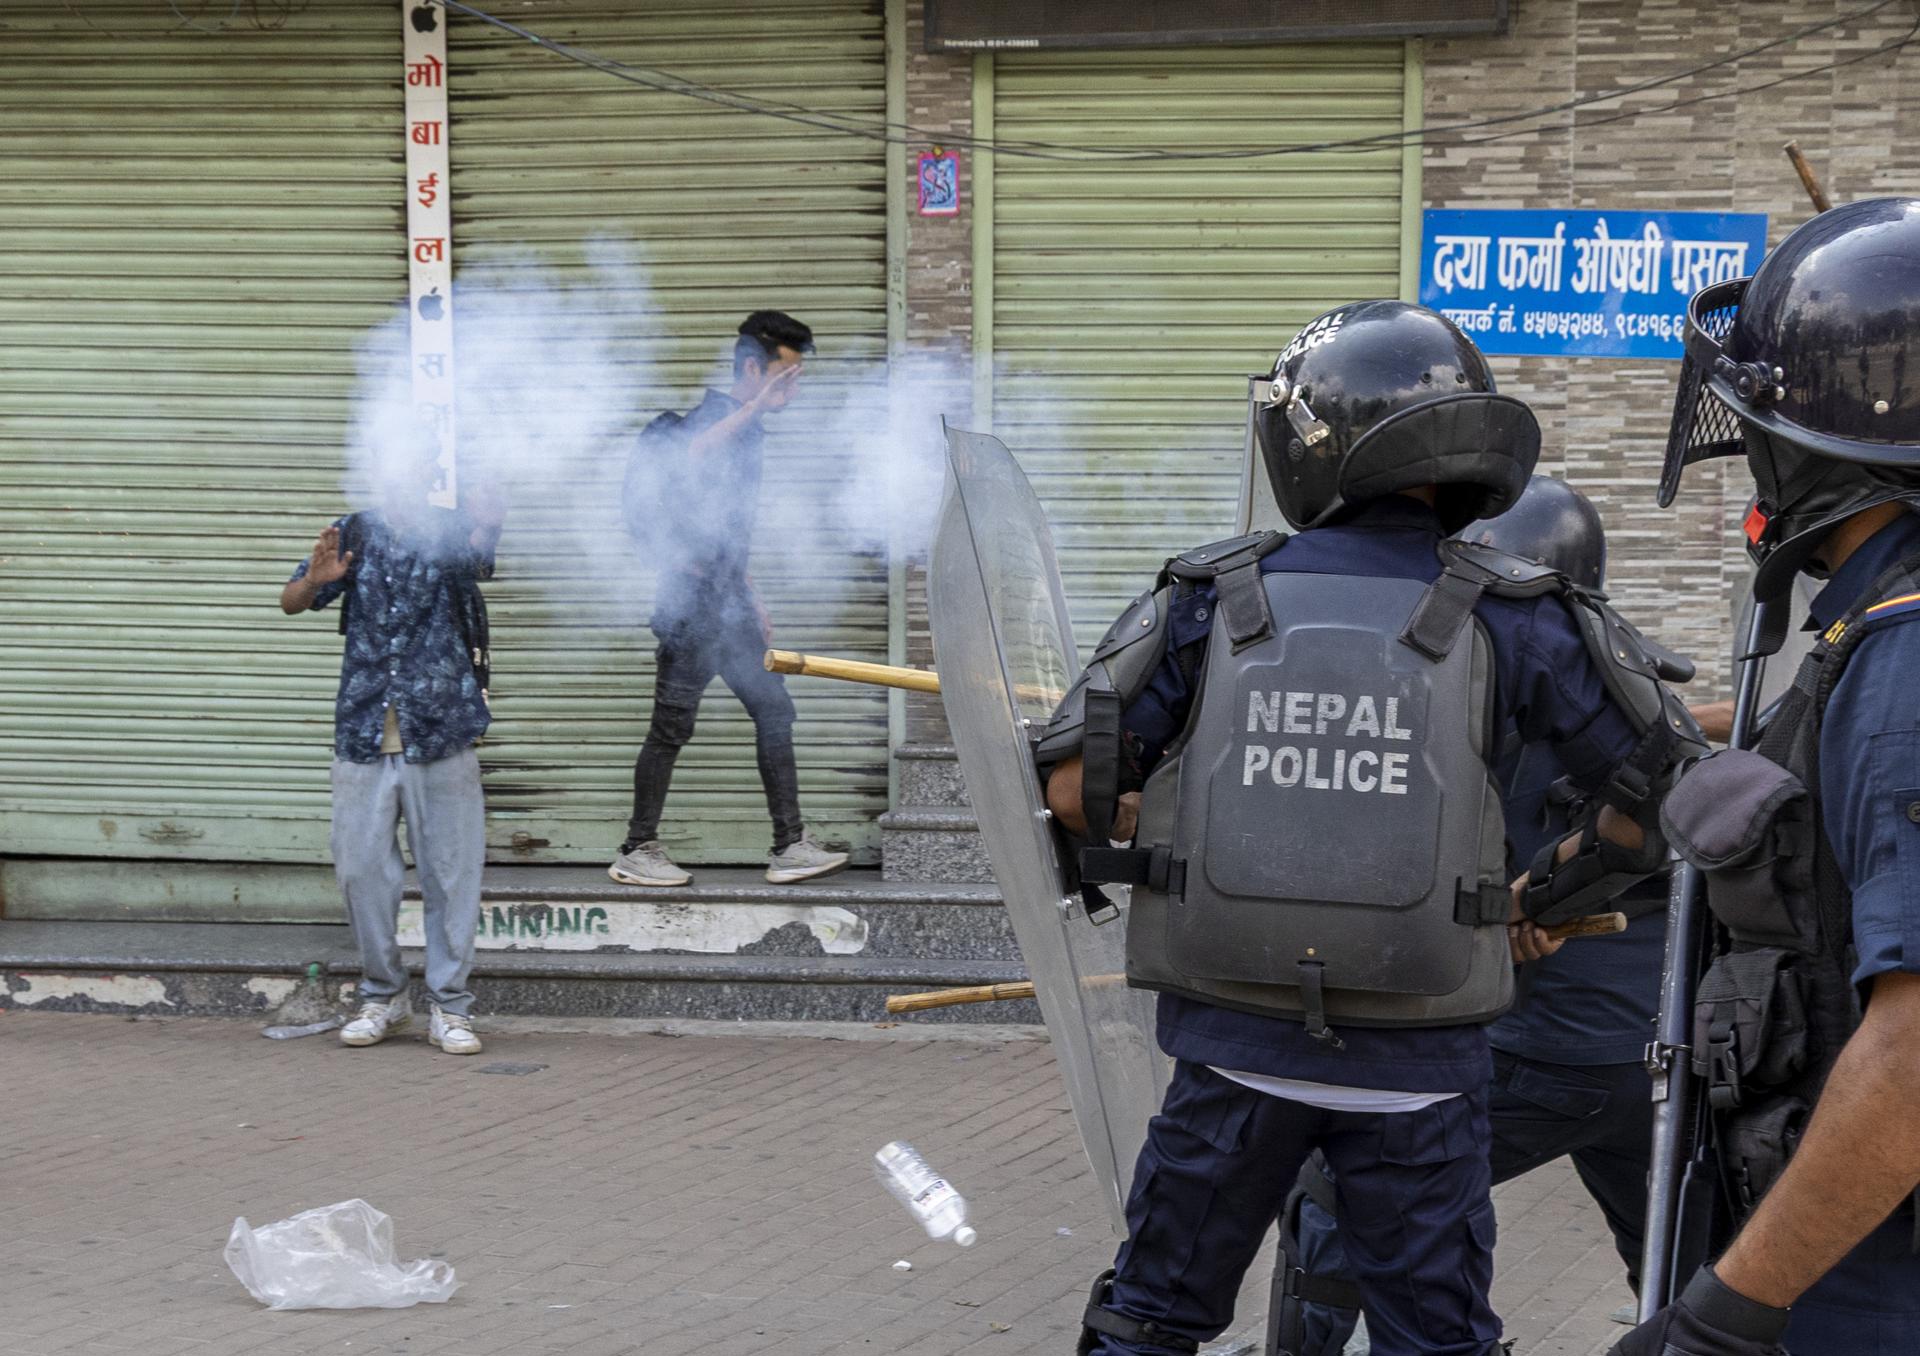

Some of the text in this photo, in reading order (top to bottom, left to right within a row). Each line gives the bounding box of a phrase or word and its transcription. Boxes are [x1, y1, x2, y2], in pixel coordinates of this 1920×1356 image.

[407, 54, 445, 262] मोबाईल
[1433, 217, 1749, 295] दया फर्मा औषधी पसल
[1275, 326, 1339, 371] POLICE
[1615, 313, 1685, 342] ९८४१६६
[1247, 690, 1412, 740] NEPAL
[1242, 745, 1410, 794] POLICE
